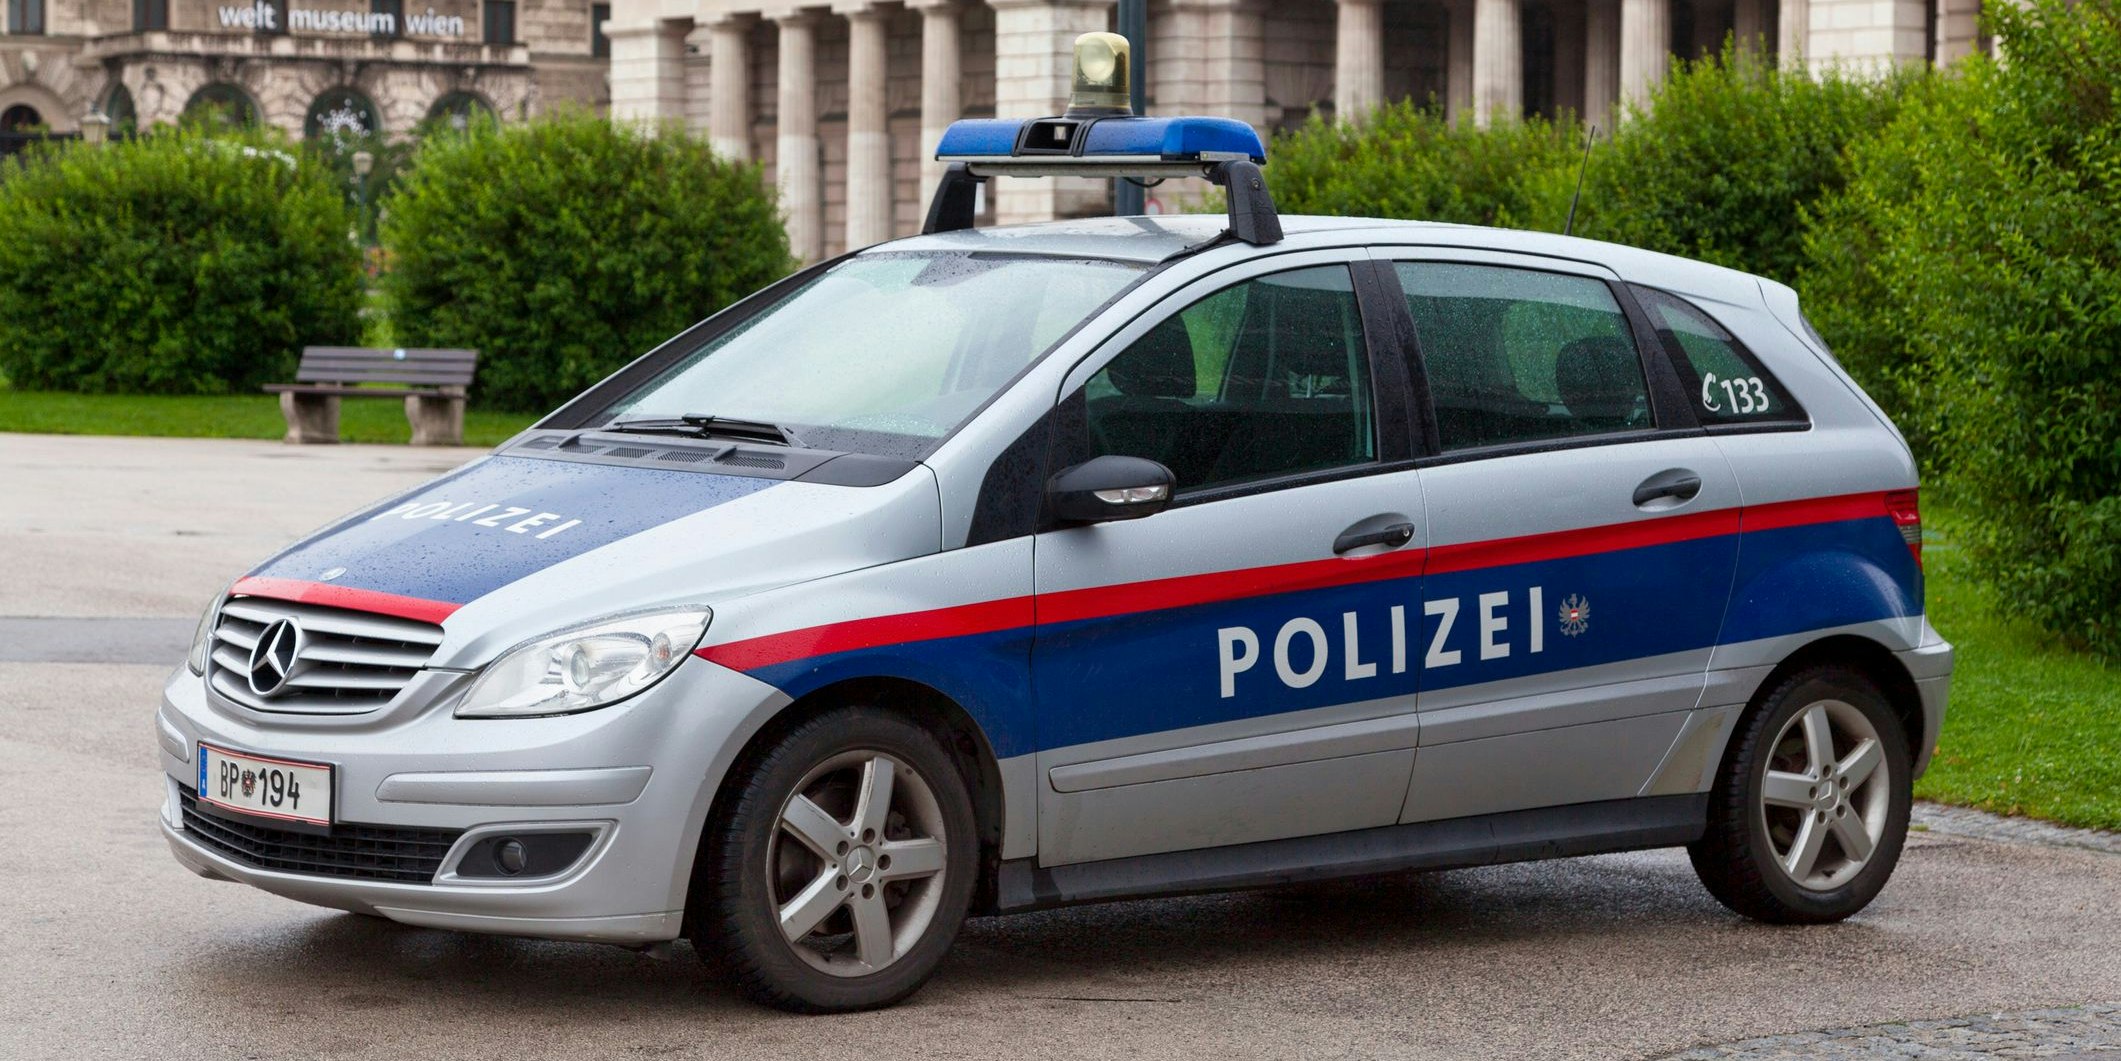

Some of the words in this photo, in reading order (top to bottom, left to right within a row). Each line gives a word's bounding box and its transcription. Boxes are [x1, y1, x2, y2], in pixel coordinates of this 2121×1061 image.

[219, 0, 277, 29] welt
[288, 8, 395, 33] museum
[405, 8, 464, 36] wien
[1720, 377, 1769, 414] 133
[371, 501, 583, 540] POLIZEI
[1217, 586, 1544, 698] POLIZEI
[220, 760, 239, 800] BP
[258, 767, 300, 810] 194
